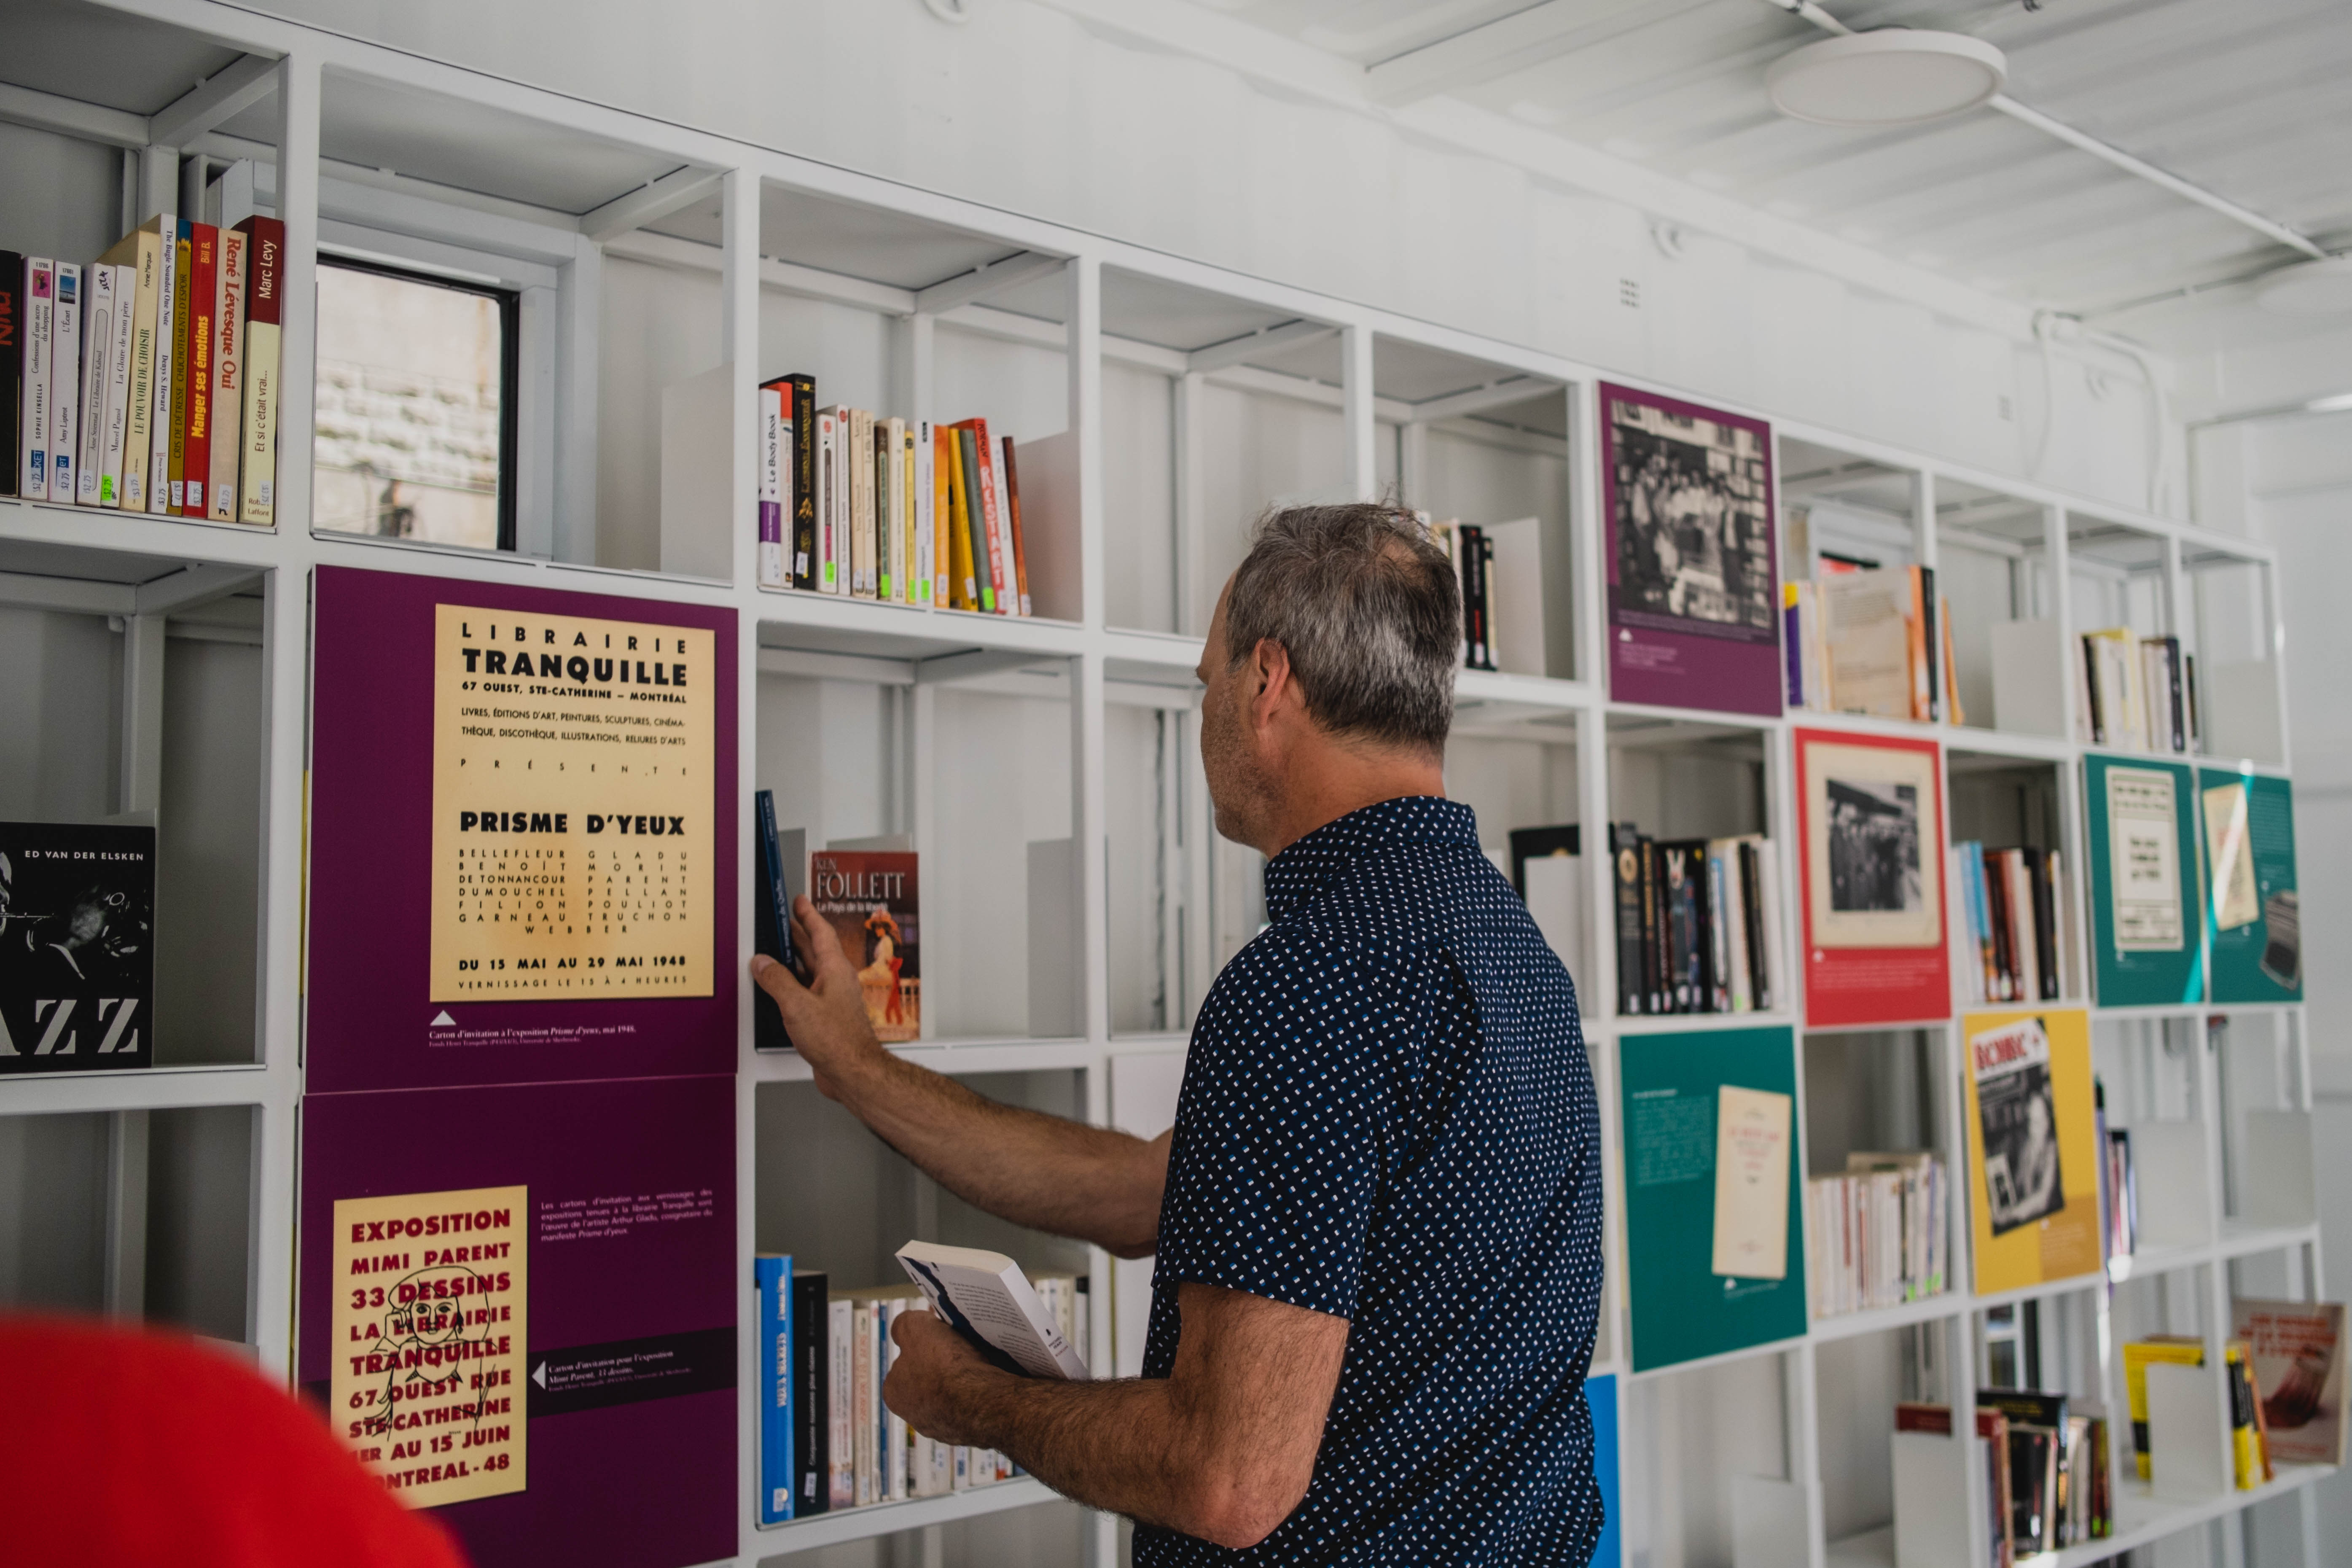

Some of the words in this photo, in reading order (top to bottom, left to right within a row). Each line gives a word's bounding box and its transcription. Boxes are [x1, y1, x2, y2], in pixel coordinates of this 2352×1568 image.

[164, 244, 172, 263] Bugle
[200, 250, 210, 264] Bill
[226, 237, 242, 277] René
[260, 239, 277, 267] Levy
[179, 274, 188, 309] D'ESPOIR
[259, 270, 272, 299] Marc
[121, 301, 130, 317] père
[220, 281, 240, 356] Lévesque
[41, 306, 49, 333] shopping
[61, 310, 70, 333] L'Écart
[118, 338, 126, 347] de
[139, 329, 150, 365] CHOISIR
[177, 312, 186, 382] CHUCHOTEMENTS
[194, 315, 209, 369] émotions
[32, 340, 40, 374] Confessions
[117, 350, 125, 371] Gloire
[160, 355, 168, 375] Denys
[116, 374, 124, 384] La
[137, 366, 148, 379] DE
[195, 371, 206, 392] ses
[221, 360, 236, 390] Oui
[257, 370, 268, 396] vrai...
[136, 381, 147, 421] POUVOIR
[174, 387, 183, 426] DÉTRESSE
[61, 407, 69, 428] Liptrot
[113, 409, 122, 429] Pagnol
[191, 394, 206, 438] Manger
[255, 399, 267, 429] c'était
[134, 422, 144, 434] LE
[175, 428, 182, 438] DE
[255, 431, 266, 440] si
[111, 432, 119, 452] Marcel
[173, 440, 182, 458] CRIS
[255, 442, 265, 452] Et
[769, 441, 777, 467] Body
[769, 470, 775, 483] Le
[462, 622, 685, 654] LIBRAIRIE
[462, 648, 687, 686] TRANQUILLE
[462, 681, 476, 691] 67
[483, 683, 523, 694] OUEST,
[530, 685, 611, 699] STE-CATHERINE
[630, 692, 686, 703] MONTRÉAL
[462, 707, 490, 718] LIVRES,
[493, 707, 530, 719] ÉDITIONS
[533, 711, 558, 721] D'ART,
[561, 713, 602, 724] PEINTURES,
[605, 715, 652, 726] SCULPTURES,
[462, 725, 496, 737] THÈQUE,
[499, 728, 558, 740] DISCOTHÈQUE,
[561, 732, 622, 744] ILLUSTRATIONS,
[625, 734, 657, 744] RELIURES
[660, 736, 686, 746] D'ARTS
[461, 758, 686, 776] PRÉSENTE
[460, 811, 567, 833] PRISME
[586, 814, 685, 835] D'YEUX
[46, 851, 68, 859] VAN
[74, 851, 96, 860] DER
[101, 852, 144, 861] ELSKEN
[460, 849, 564, 858] BELLEFLEUR
[589, 850, 686, 859] GLADU
[589, 863, 686, 871] MORIN
[589, 875, 685, 884] PARENT
[817, 872, 905, 899] FOLLETT
[460, 888, 564, 896] DUMOUCHEL
[589, 888, 686, 896] PELLAN
[460, 901, 565, 909] FILION
[589, 900, 686, 909] POULIOT
[459, 913, 565, 923] GARNEAU
[589, 913, 686, 921] TRUCHON
[525, 925, 626, 934] WEBBER
[459, 960, 478, 970] DU
[490, 959, 505, 970] 15
[517, 958, 546, 969] MAI
[557, 957, 577, 968] AU
[588, 957, 605, 968] 29
[616, 957, 643, 967] MAI
[653, 956, 686, 966] 1948
[459, 979, 547, 989] VERNISSAGE
[558, 978, 570, 987] LE
[636, 975, 686, 984] HEURES
[429, 1030, 455, 1039] Carton
[457, 1029, 499, 1038] d'invitation
[501, 1029, 505, 1037] à
[507, 1027, 548, 1038] l'exposition
[551, 1027, 574, 1035] Prisme
[603, 1025, 616, 1034] mai
[541, 1202, 554, 1210] Les
[560, 1200, 586, 1208] cartons
[592, 1196, 632, 1206] d'invitation
[700, 1189, 712, 1197] des
[541, 1211, 582, 1221] expositions
[586, 1209, 610, 1217] tenues
[571, 1220, 581, 1229] de
[612, 1216, 634, 1225] Arthur
[352, 1208, 510, 1243] EXPOSITION
[541, 1232, 577, 1241] manifeste
[578, 1230, 602, 1238] Prisme
[350, 1253, 409, 1275] MIMI
[424, 1242, 511, 1267] PARENT
[350, 1287, 385, 1310] 33
[398, 1272, 511, 1304] DESSINS
[350, 1323, 380, 1342] LA
[394, 1305, 511, 1336] LIBRAIRIE
[350, 1336, 511, 1376] TRANQUILLE
[548, 1364, 573, 1374] Carton
[349, 1389, 378, 1409] 67
[389, 1377, 457, 1404] OUEST
[471, 1369, 511, 1390] RUE
[349, 1397, 511, 1439] STE-CATHERINE
[390, 1439, 422, 1460] AU
[430, 1434, 453, 1454] 15
[462, 1425, 510, 1449] JUIN
[483, 1453, 510, 1471] 48
